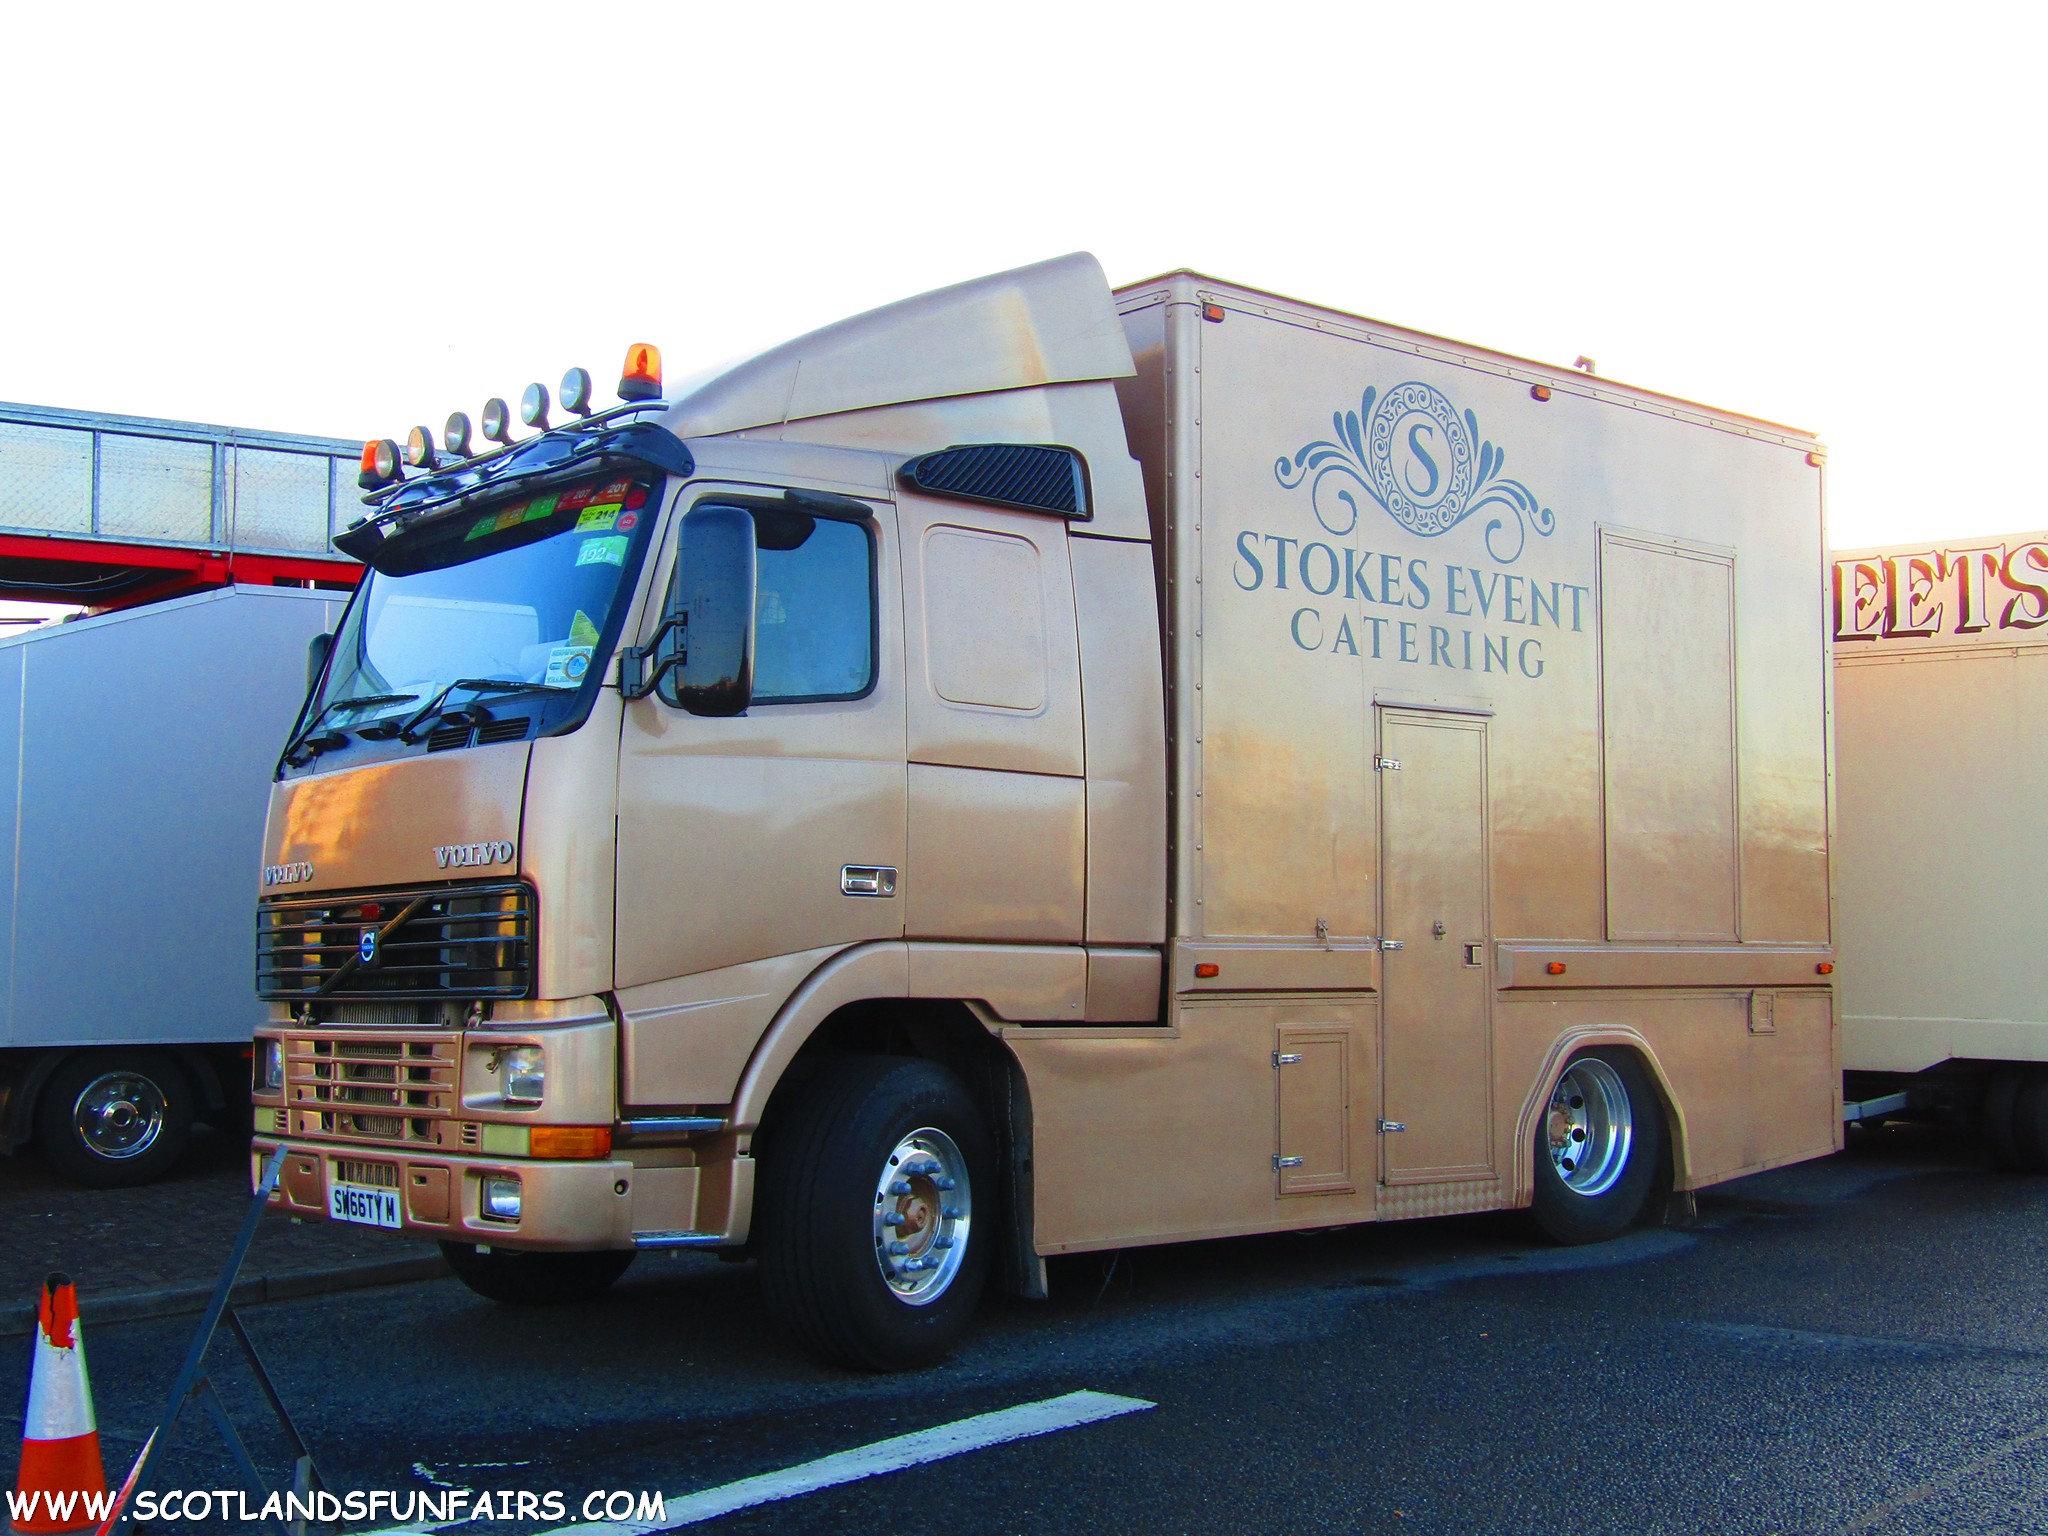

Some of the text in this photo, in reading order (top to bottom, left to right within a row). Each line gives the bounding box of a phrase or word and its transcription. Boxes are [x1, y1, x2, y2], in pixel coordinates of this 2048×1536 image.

[1403, 423, 1440, 498] S
[607, 482, 627, 494] 201
[595, 509, 617, 521] 214
[580, 546, 607, 563] 192
[1233, 530, 1590, 634] STOKES EVENT
[1832, 542, 2048, 642] EETS
[1290, 607, 1546, 680] CATERING
[432, 840, 513, 869] VOLVO
[264, 860, 314, 886] VOLVO
